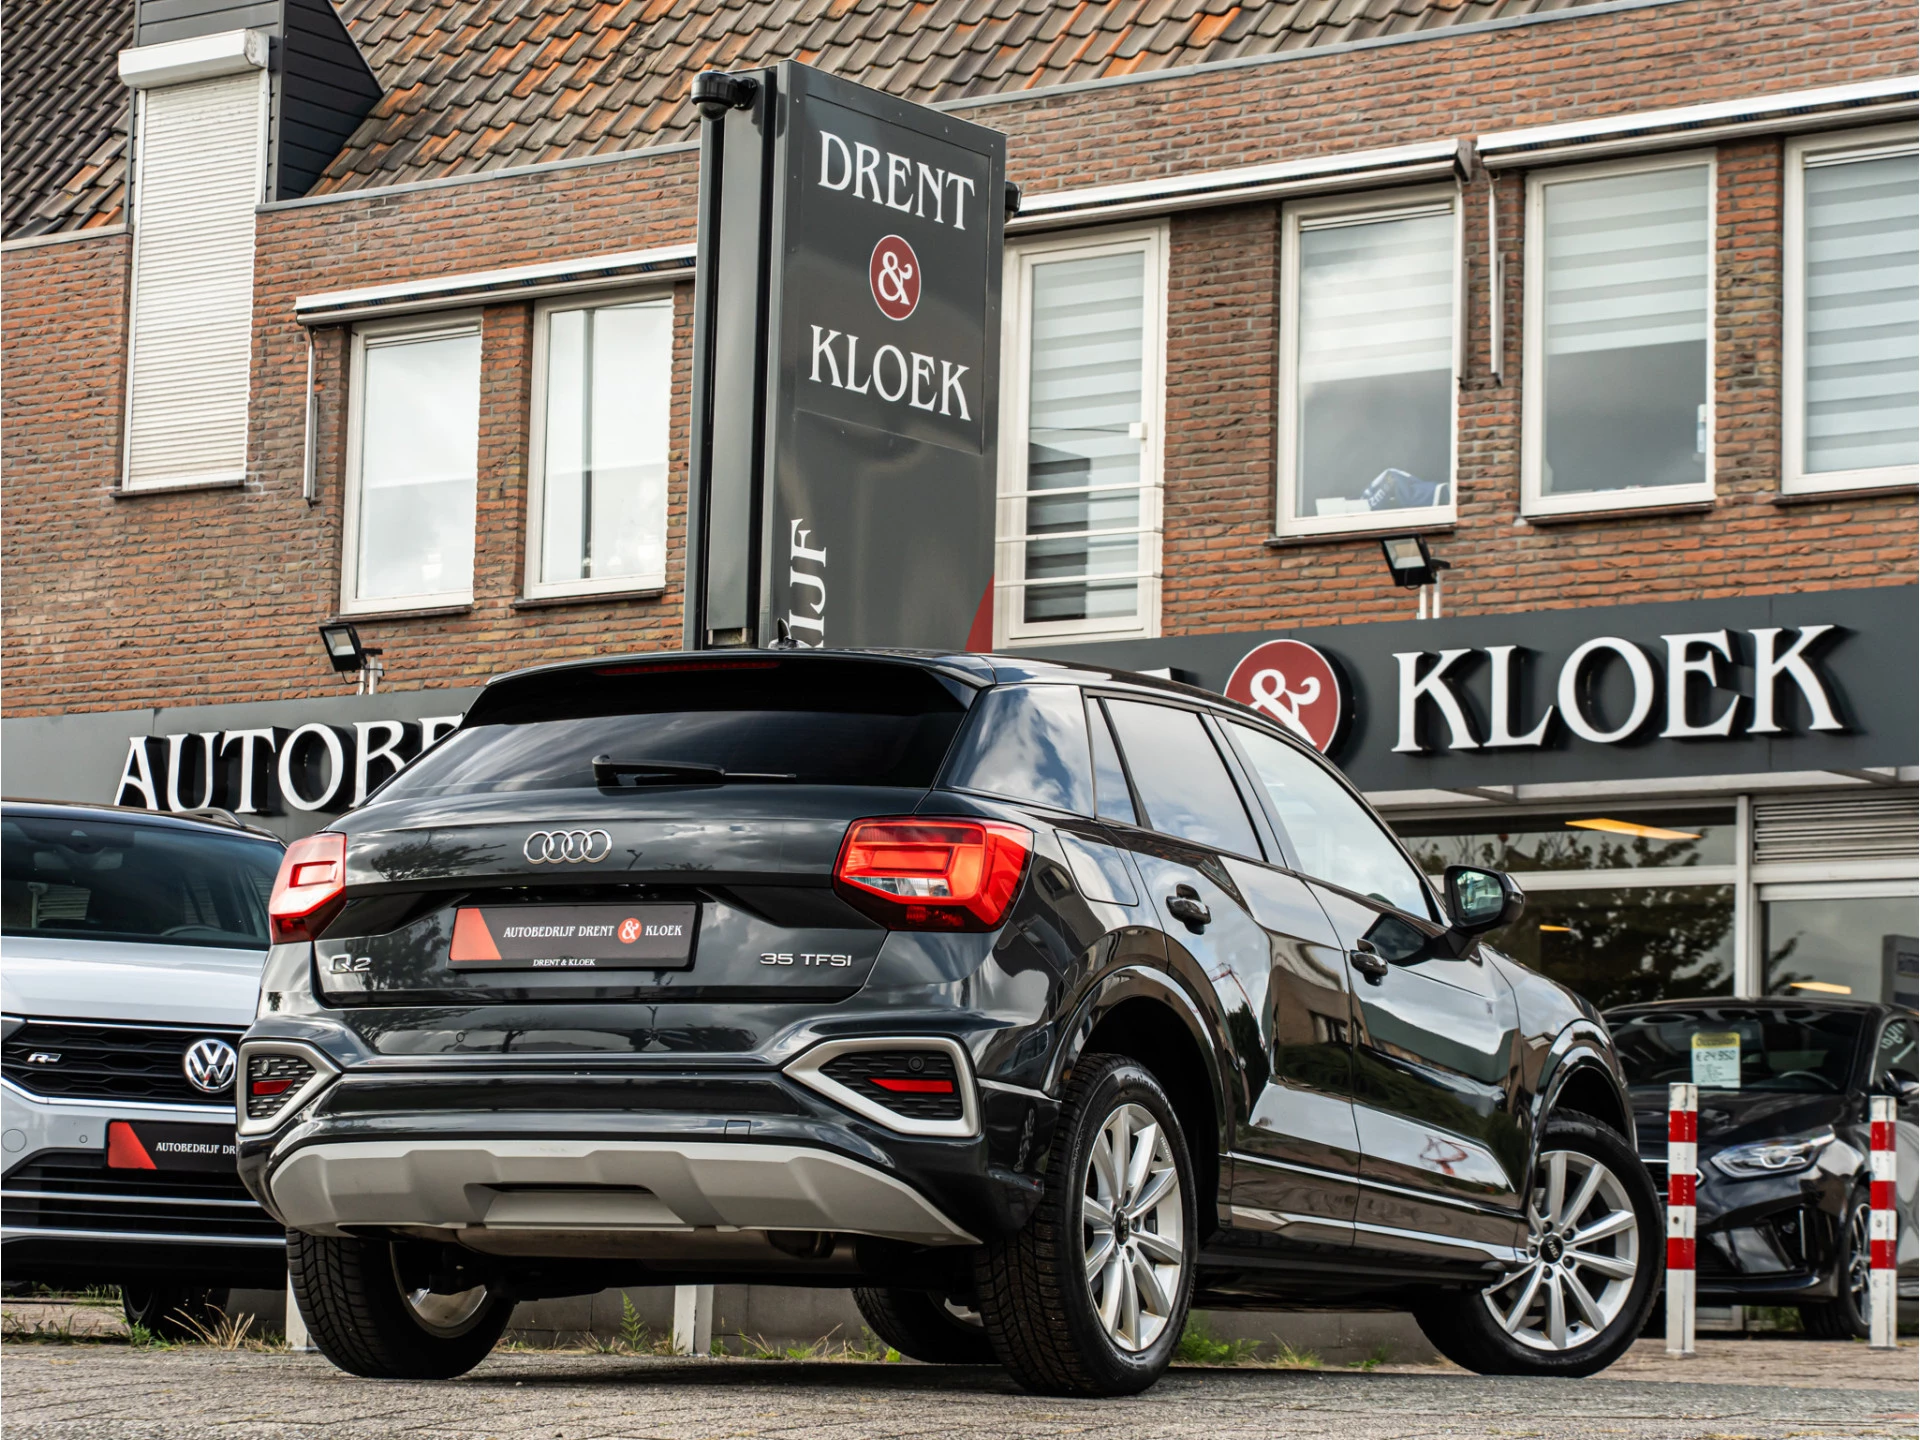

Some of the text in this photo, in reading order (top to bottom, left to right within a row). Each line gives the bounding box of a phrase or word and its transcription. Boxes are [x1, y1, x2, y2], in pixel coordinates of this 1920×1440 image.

[817, 130, 975, 230] DRENT
[878, 251, 912, 305] &
[809, 325, 972, 421] KLOEK
[789, 519, 826, 648] IJF
[1391, 625, 1843, 752] KLOEK
[502, 920, 683, 940] AUTOBEDRIJF DRENT & KLOEK
[329, 954, 371, 973] Q2
[532, 959, 560, 967] DRENT
[760, 952, 852, 967] 35 TFSI
[155, 1142, 220, 1154] AUTOBEDRIJF
